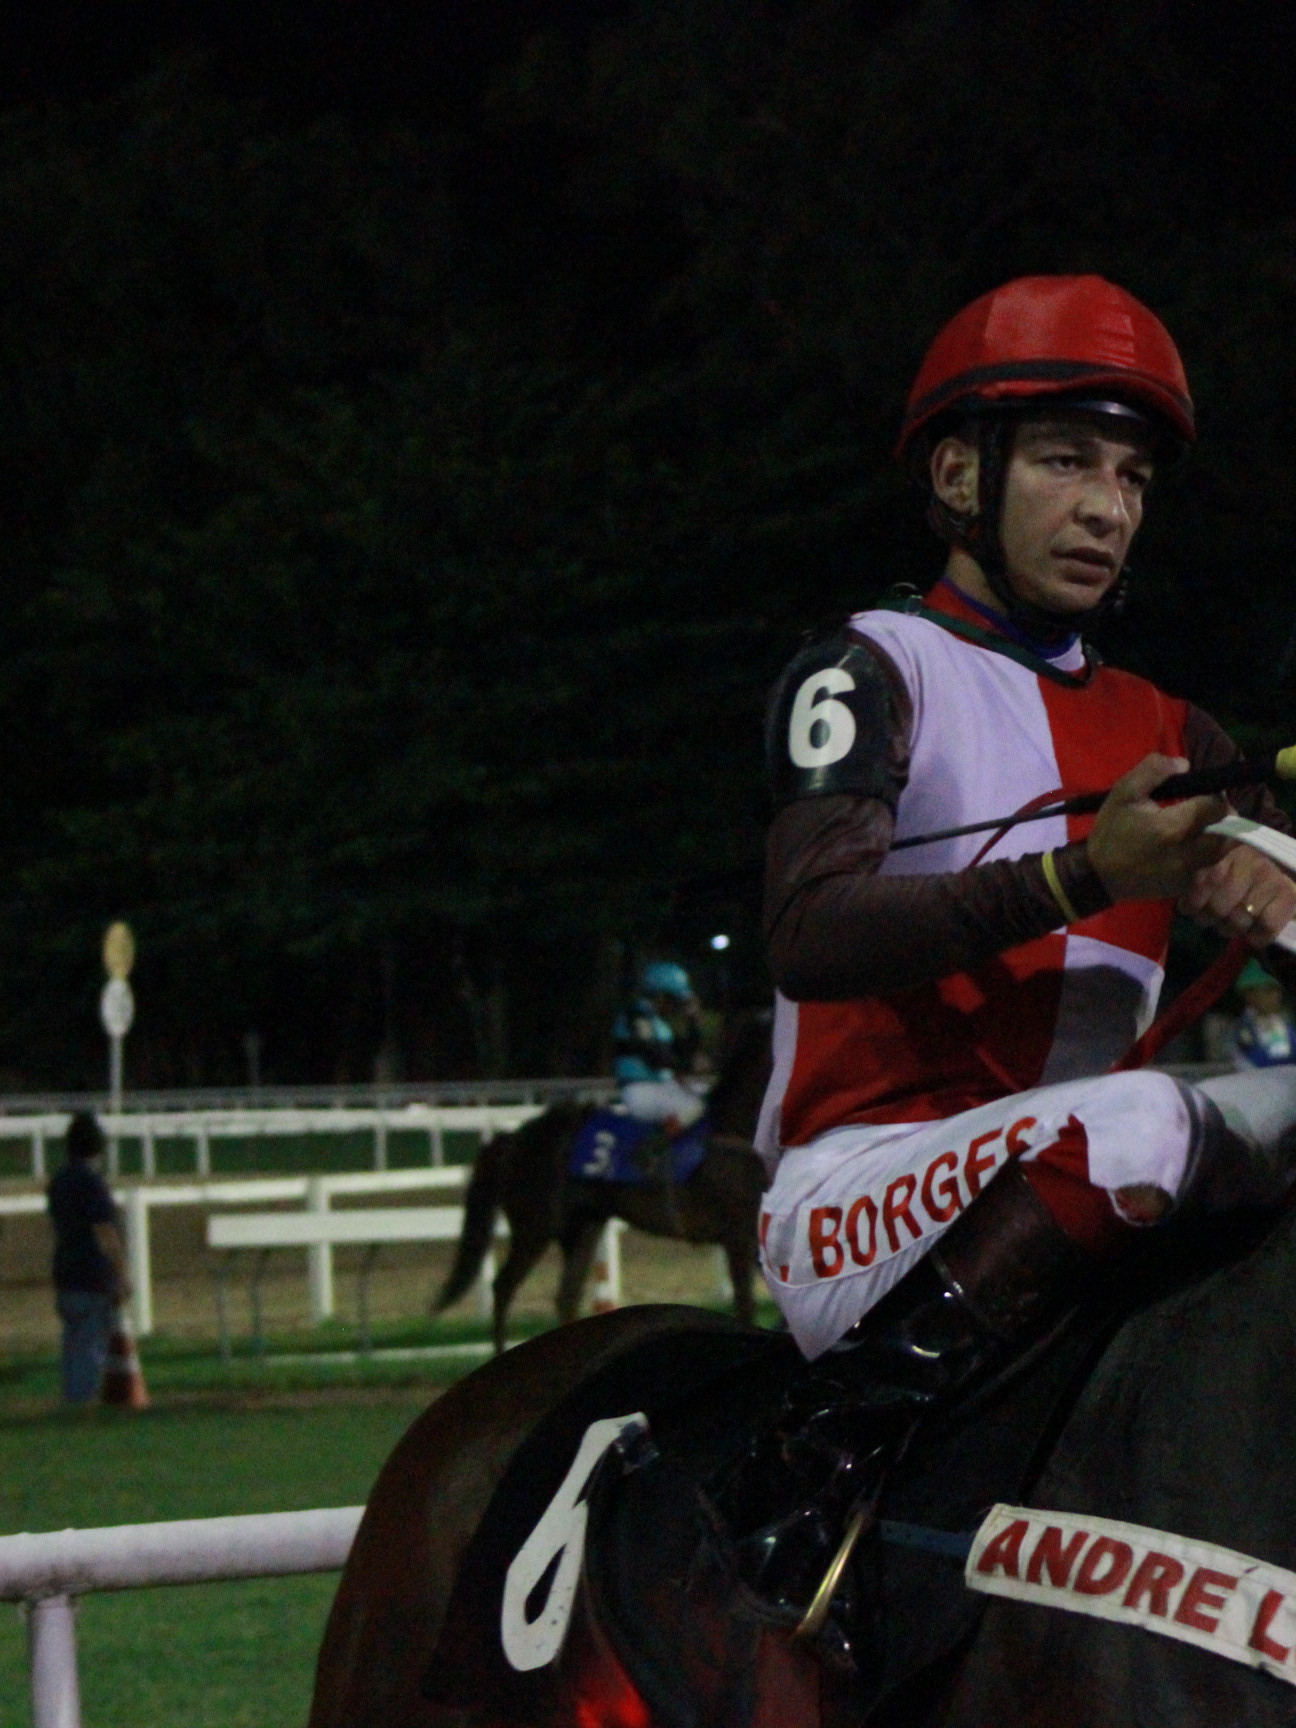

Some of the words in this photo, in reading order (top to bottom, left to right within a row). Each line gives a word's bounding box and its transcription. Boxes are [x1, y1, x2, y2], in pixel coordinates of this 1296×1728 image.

[788, 667, 857, 769] 6
[501, 1410, 651, 1673] 6
[976, 1519, 1238, 1634] ANDRE
